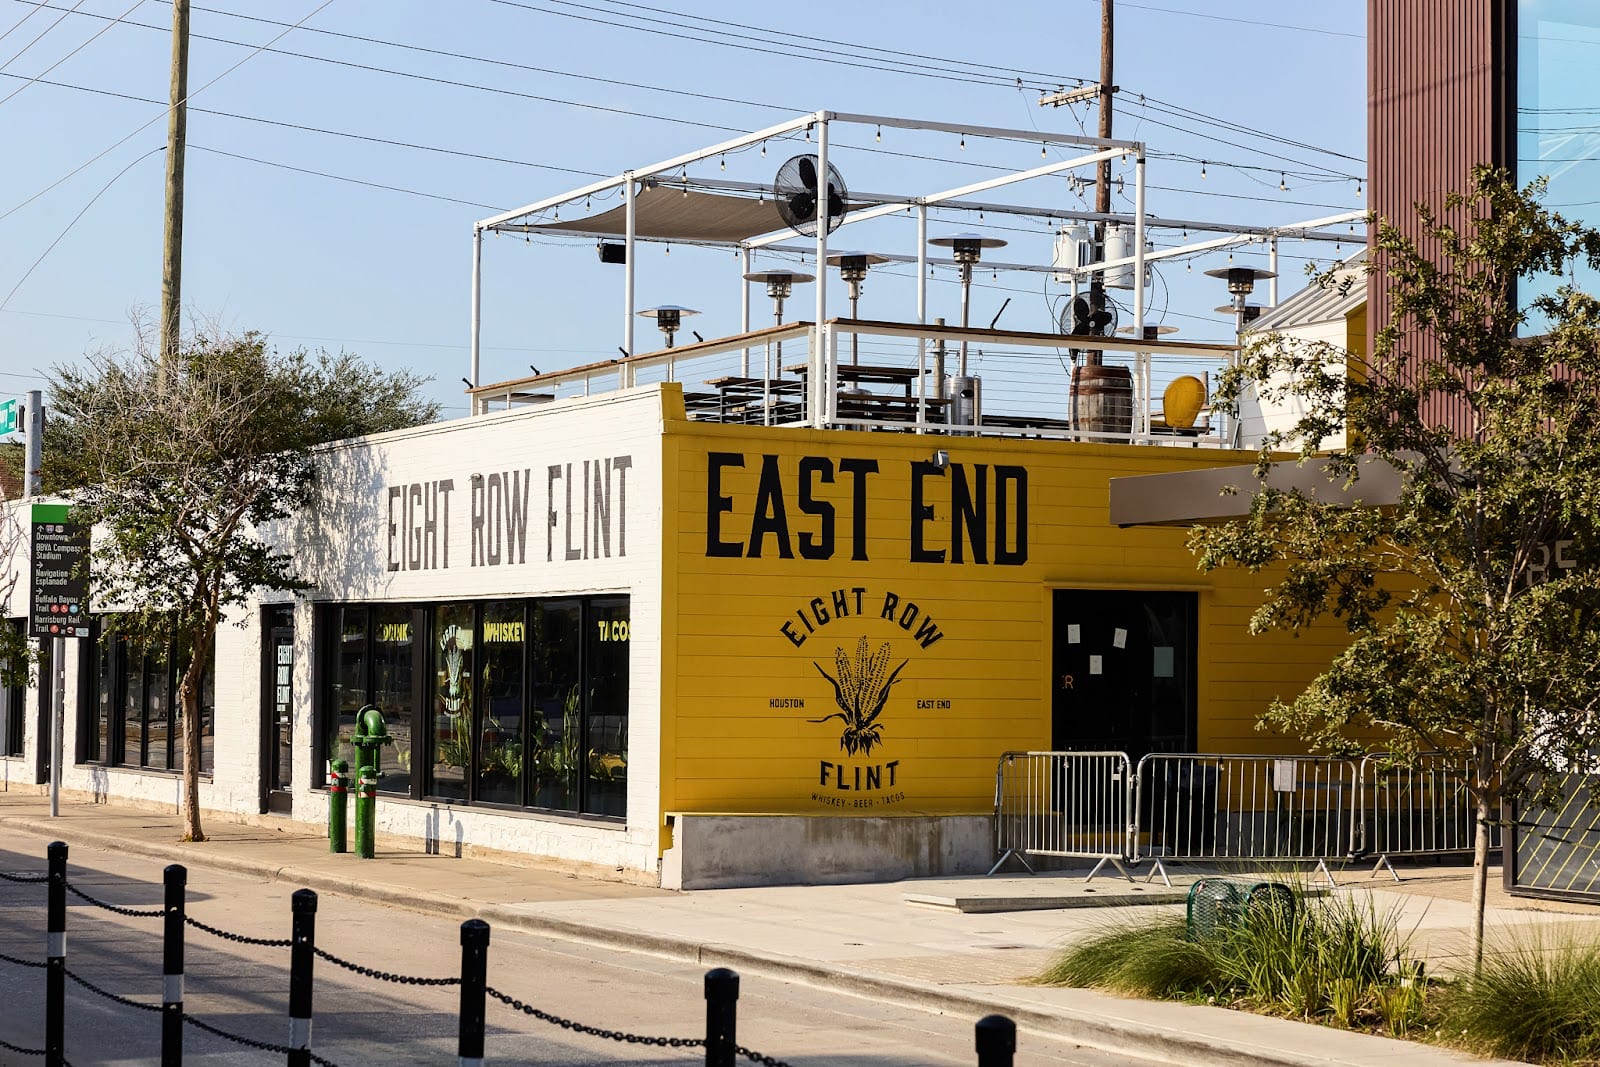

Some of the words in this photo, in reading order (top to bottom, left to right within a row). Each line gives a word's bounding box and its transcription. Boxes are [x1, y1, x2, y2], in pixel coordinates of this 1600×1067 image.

[387, 479, 455, 572] EIGHT
[470, 468, 531, 567] ROW
[547, 455, 633, 562] FLINT
[705, 451, 880, 561] EAST
[910, 460, 1028, 566] END
[36, 543, 52, 551] BBVA
[53, 543, 81, 553] Compass
[36, 551, 62, 560] Stadium
[36, 569, 69, 578] Navigation
[36, 577, 68, 586] Esplanade
[35, 595, 58, 603] Buffalo
[59, 595, 79, 605] Bayou
[35, 604, 50, 612] Trail
[35, 614, 67, 626] Harrisburg
[68, 615, 80, 624] Rail
[780, 587, 866, 648] EIGHT
[880, 591, 945, 650] ROW
[35, 624, 50, 633] Trail
[383, 623, 409, 641] DRINK
[483, 622, 525, 643] WHISKEY
[769, 698, 805, 708] HOUSTON
[917, 699, 936, 709] EAST
[937, 699, 951, 709] END
[820, 760, 900, 791] FLINT
[811, 792, 846, 808] WHISKEY
[854, 800, 873, 808] BEER
[881, 792, 905, 805] TACOS
